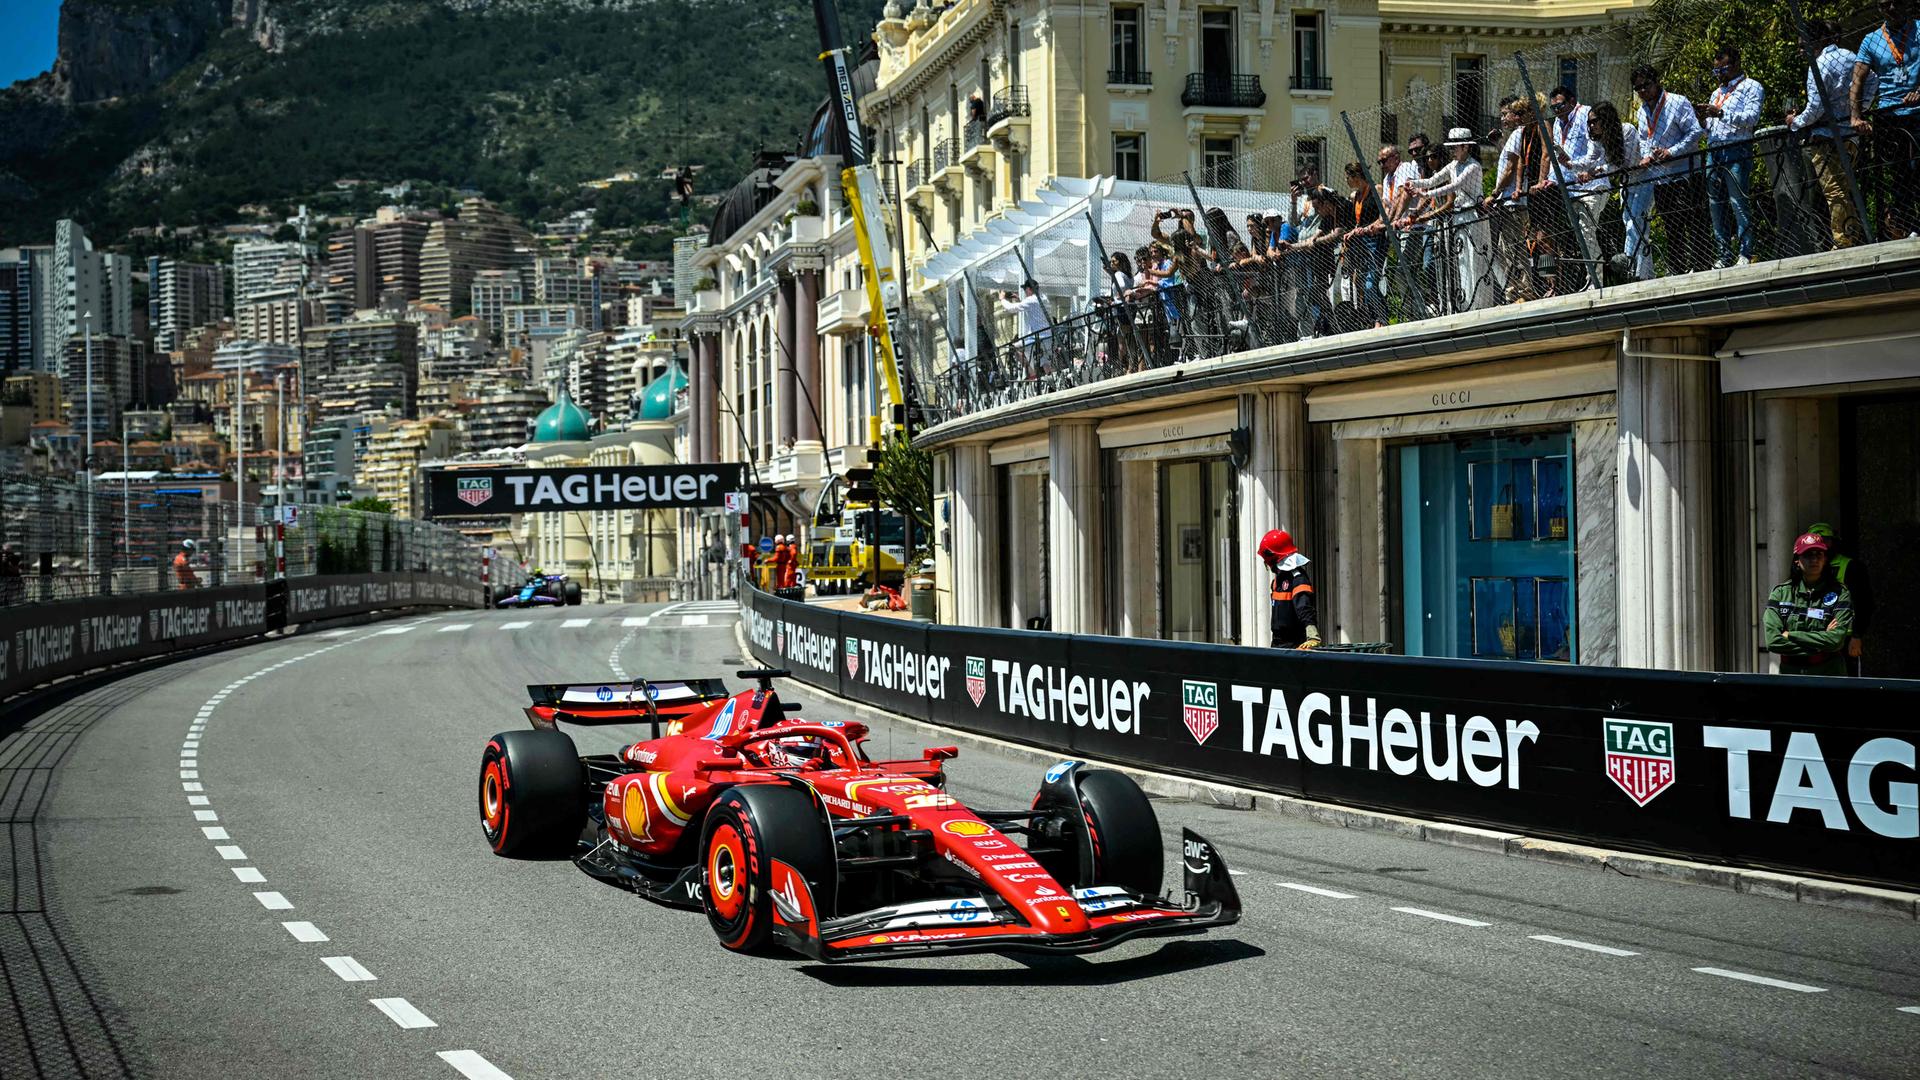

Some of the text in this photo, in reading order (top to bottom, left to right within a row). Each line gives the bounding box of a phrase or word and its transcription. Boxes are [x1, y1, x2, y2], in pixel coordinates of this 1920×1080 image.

[1432, 391, 1471, 406] GUCCI
[1162, 426, 1184, 438] GUCCI
[461, 480, 489, 489] TAG
[460, 490, 490, 503] HEUER
[967, 660, 984, 676] TAG
[598, 687, 612, 701] hp
[967, 679, 985, 702] HEUER
[1185, 685, 1215, 706] TAG
[1185, 709, 1216, 741] HEUER
[1609, 725, 1667, 753] TAG
[1610, 757, 1670, 798] HEUER
[822, 793, 851, 809] RICHARD
[904, 794, 957, 810] 16
[737, 810, 758, 875] ZERO
[1184, 839, 1209, 861] aws
[890, 932, 966, 943] V-Power
